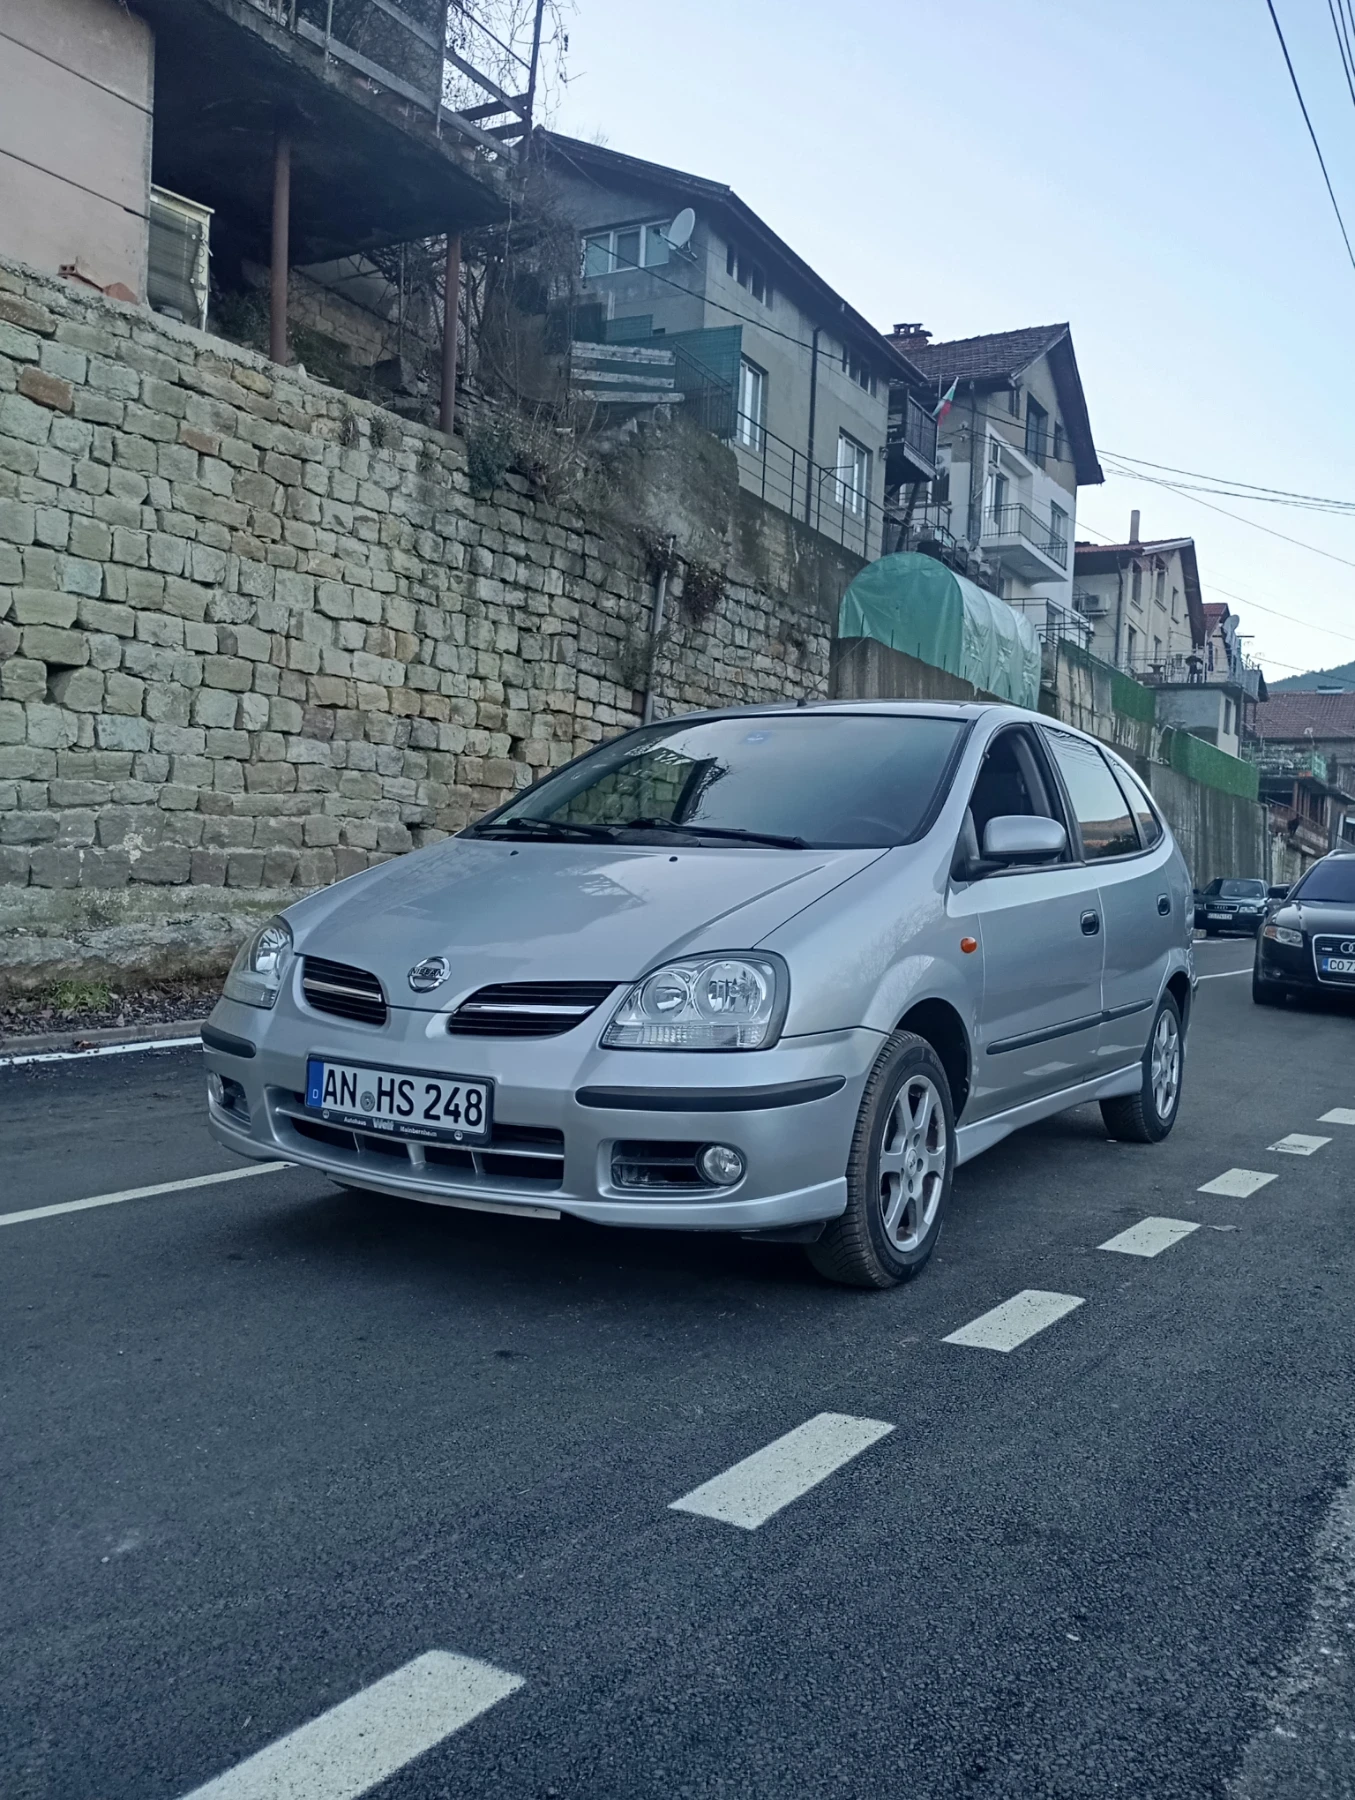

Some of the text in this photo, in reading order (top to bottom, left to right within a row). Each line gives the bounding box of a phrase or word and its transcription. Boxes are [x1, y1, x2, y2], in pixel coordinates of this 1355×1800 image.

[1346, 961, 1355, 972] 7
[312, 1089, 319, 1099] D
[323, 1069, 482, 1126] AN HS 248
[343, 1116, 367, 1126] Autohaus
